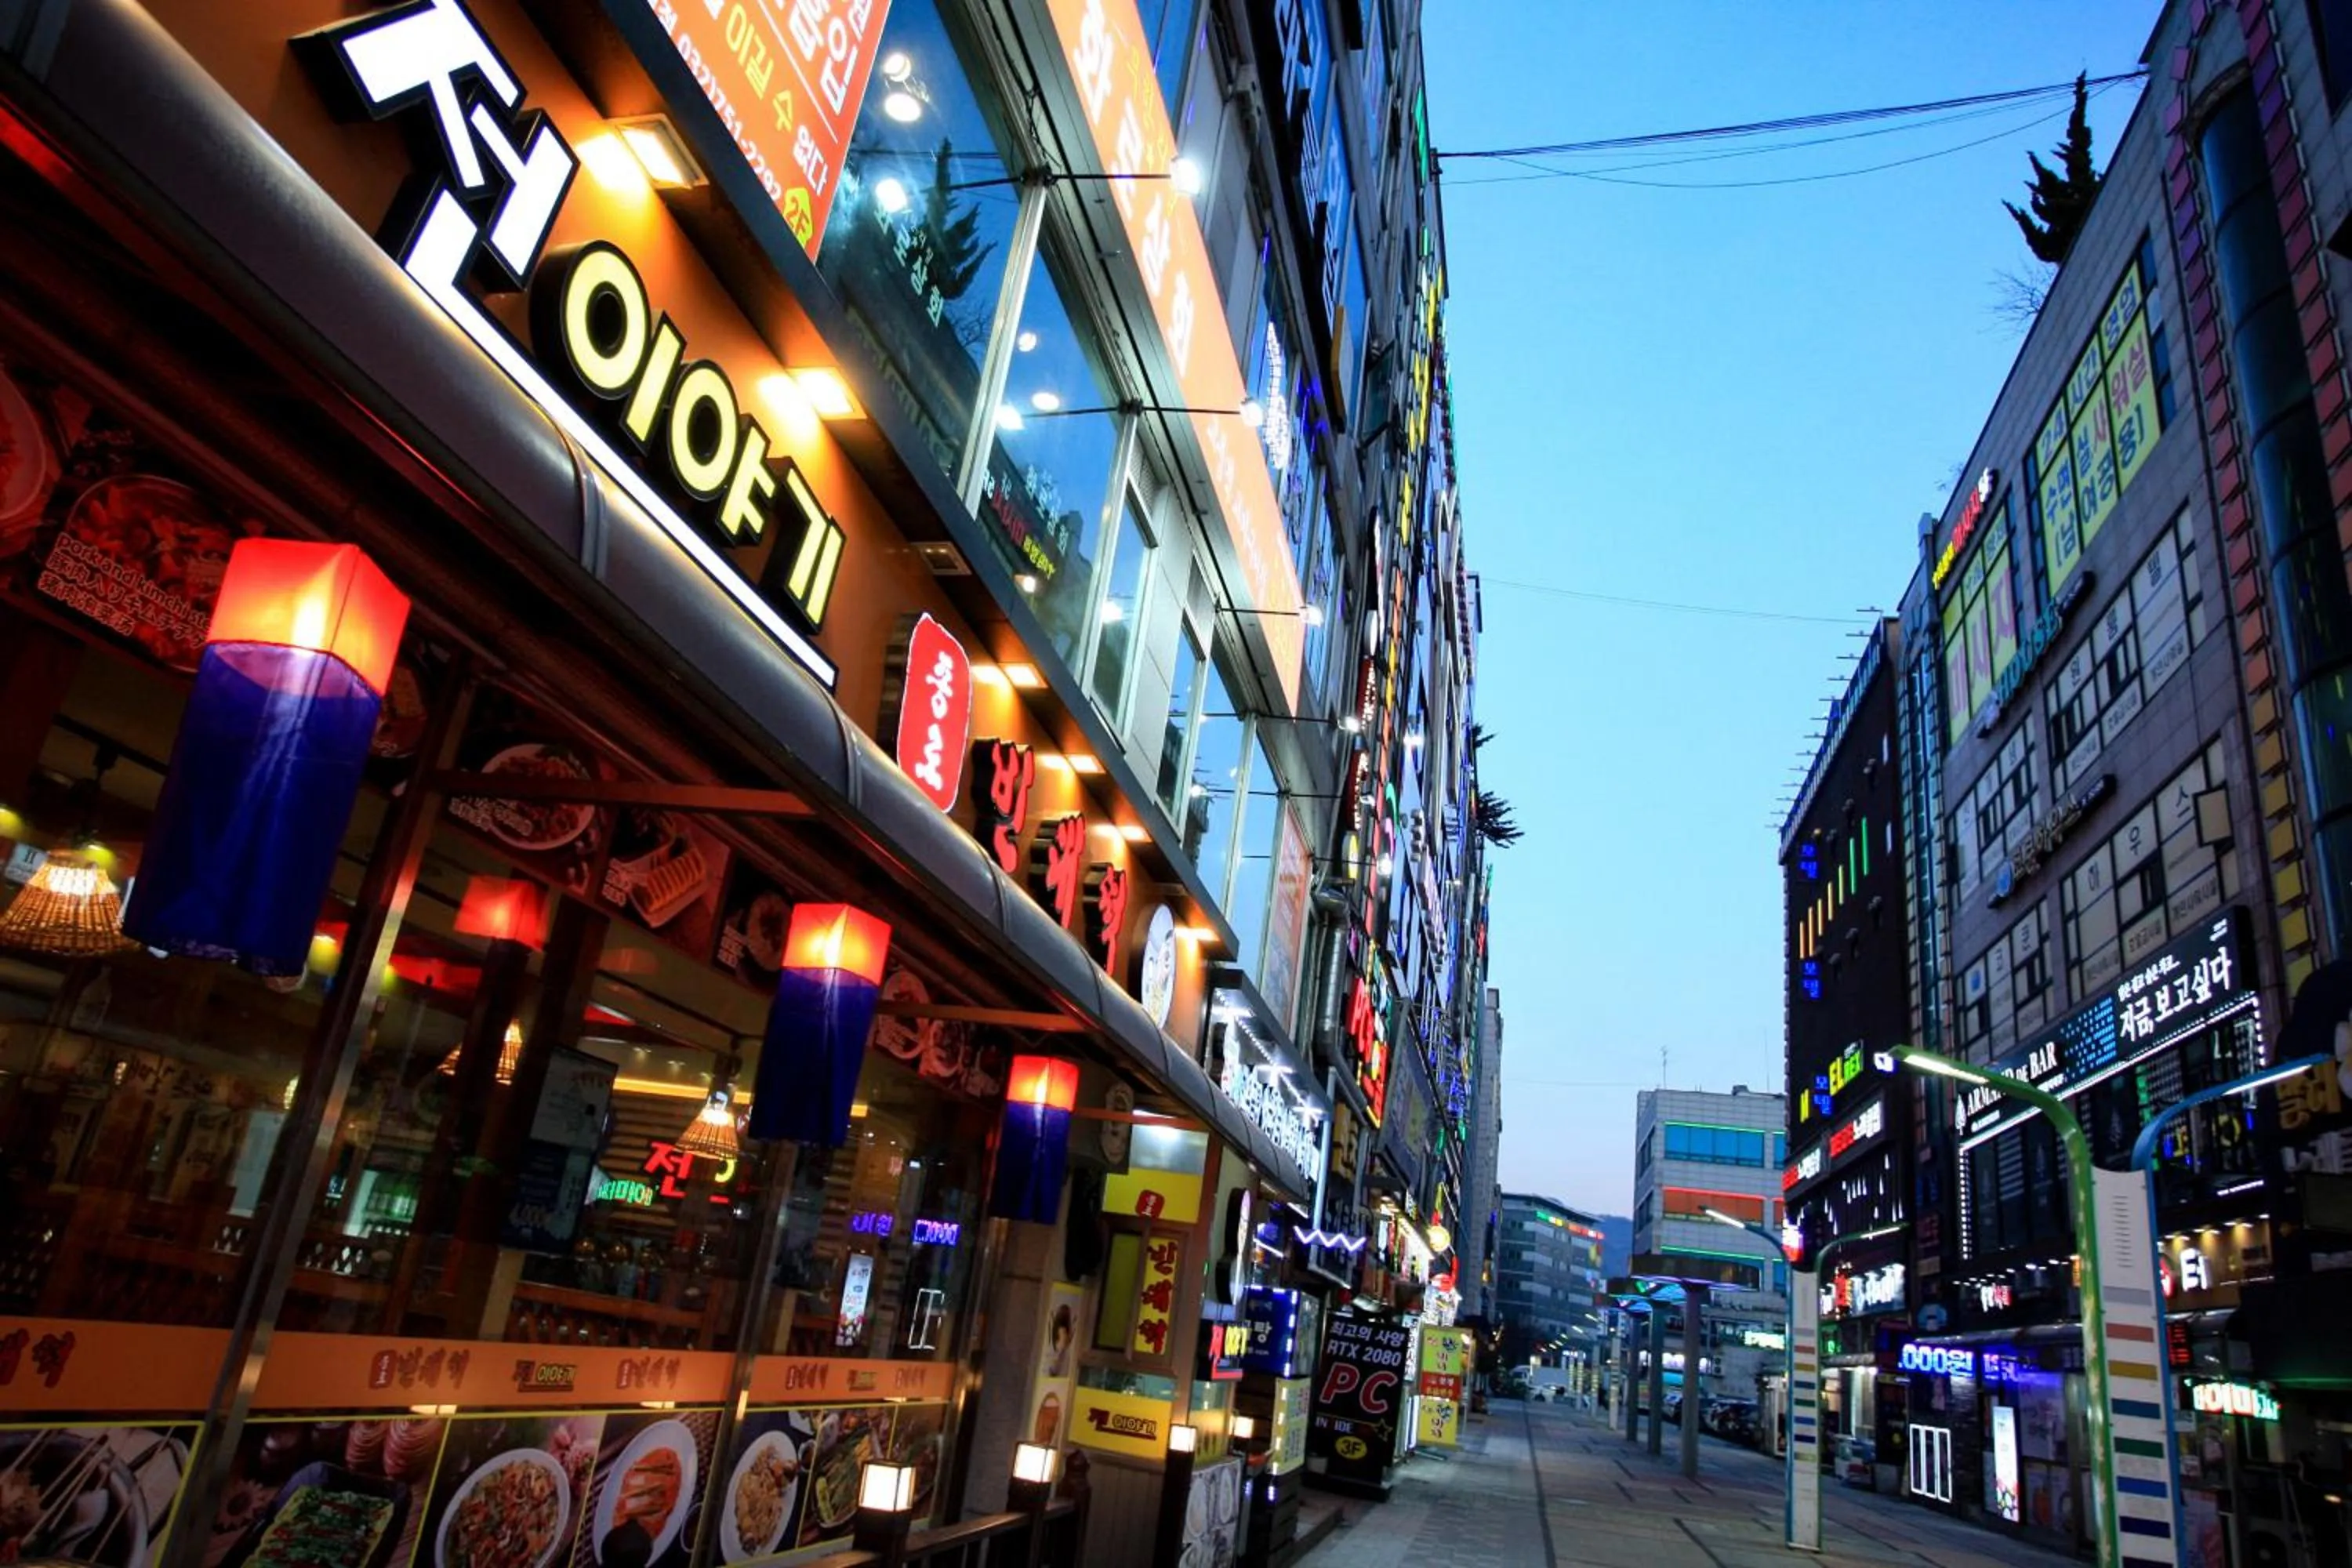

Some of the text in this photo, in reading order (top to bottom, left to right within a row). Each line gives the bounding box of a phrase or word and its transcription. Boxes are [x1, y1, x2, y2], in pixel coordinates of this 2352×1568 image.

[725, 3, 829, 196] 이길 수 없다
[2103, 275, 2138, 353] 영업
[564, 247, 845, 626] 이야기
[55, 532, 100, 568] pork
[100, 557, 138, 586] and
[135, 573, 191, 620] kimchi
[2154, 946, 2234, 1024] 보고싶다
[2028, 1041, 2058, 1080] BAR
[643, 1141, 696, 1198] 전
[1326, 1339, 1361, 1359] RTX
[1363, 1347, 1402, 1367] 2080
[1330, 1321, 1405, 1348] 최고의 사양
[1319, 1361, 1399, 1414] PC
[1111, 1413, 1158, 1437] 이야기
[1339, 1439, 1363, 1456] 3F
